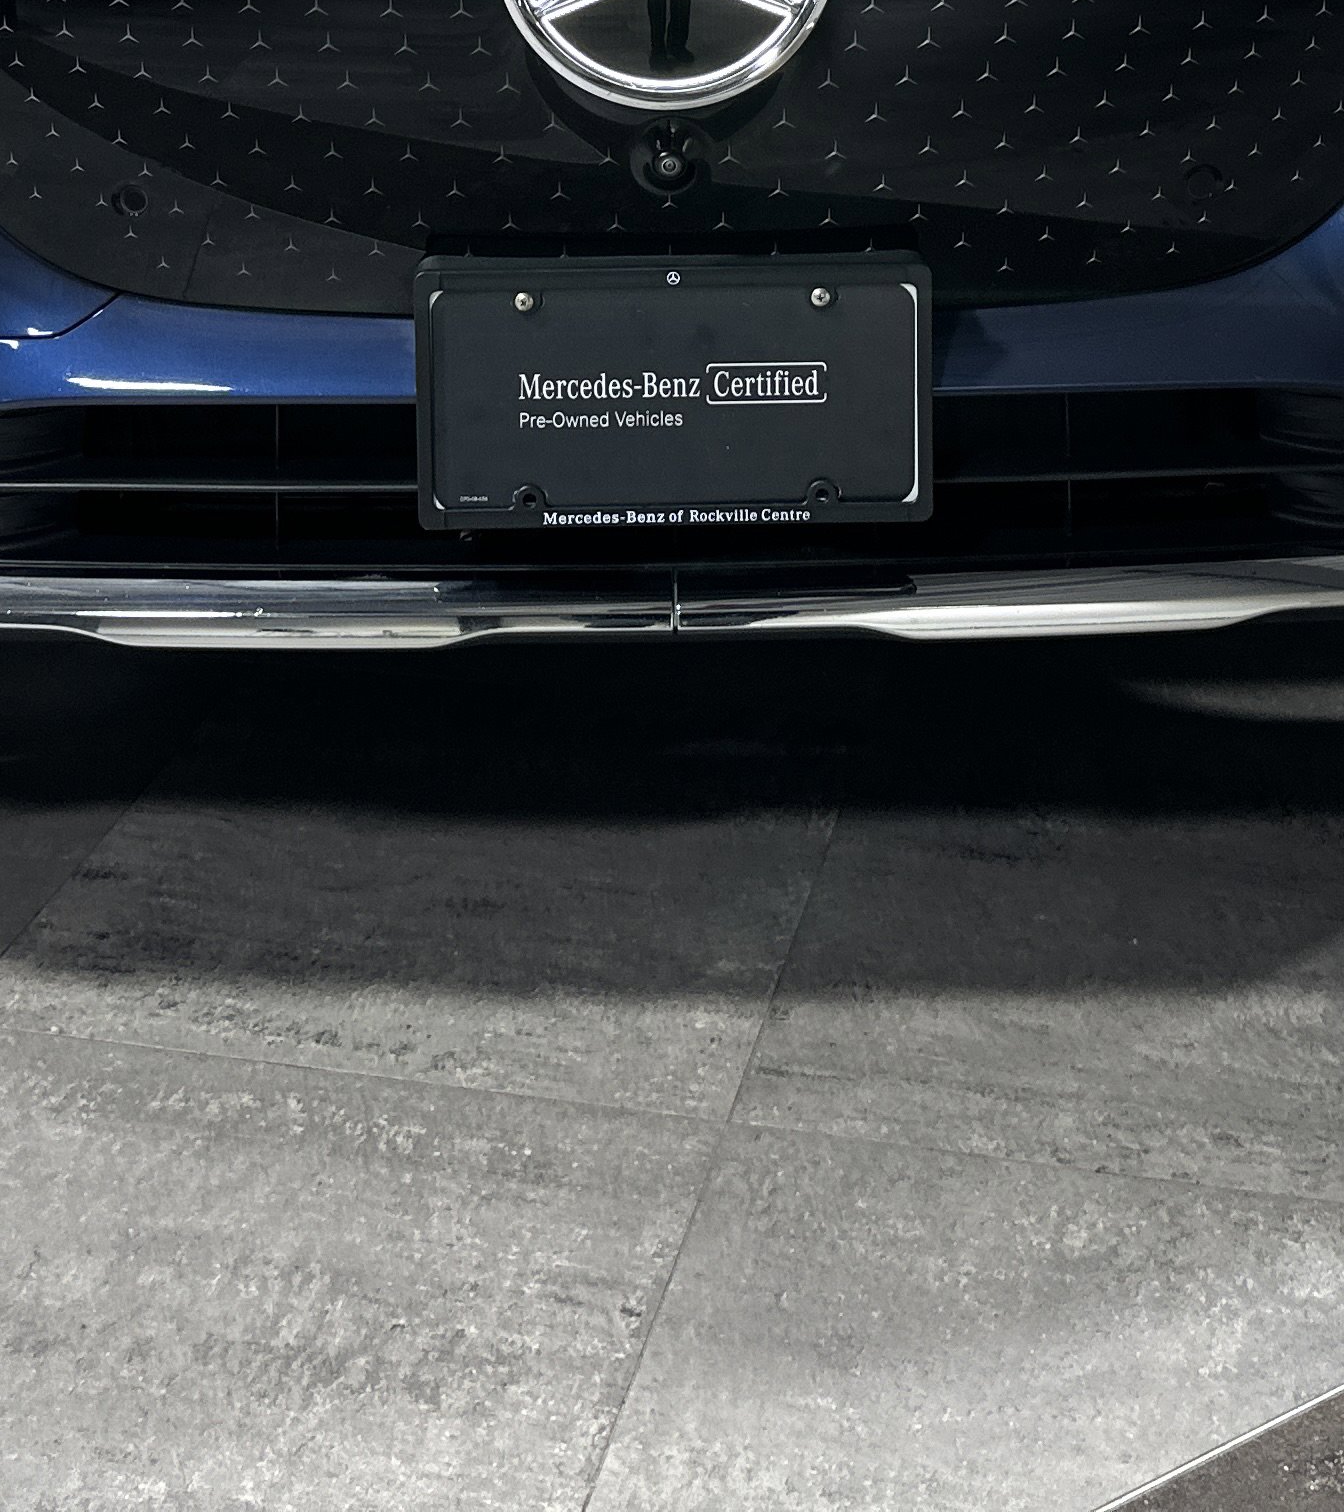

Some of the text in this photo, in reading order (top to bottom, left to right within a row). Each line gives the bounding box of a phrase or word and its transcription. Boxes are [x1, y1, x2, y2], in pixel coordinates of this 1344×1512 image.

[518, 369, 820, 400] Mercedes-Benz Certified
[519, 410, 684, 429] Pre-Owned Vehicles
[542, 508, 811, 525] Mercedes-Benz of Rockville Centre
